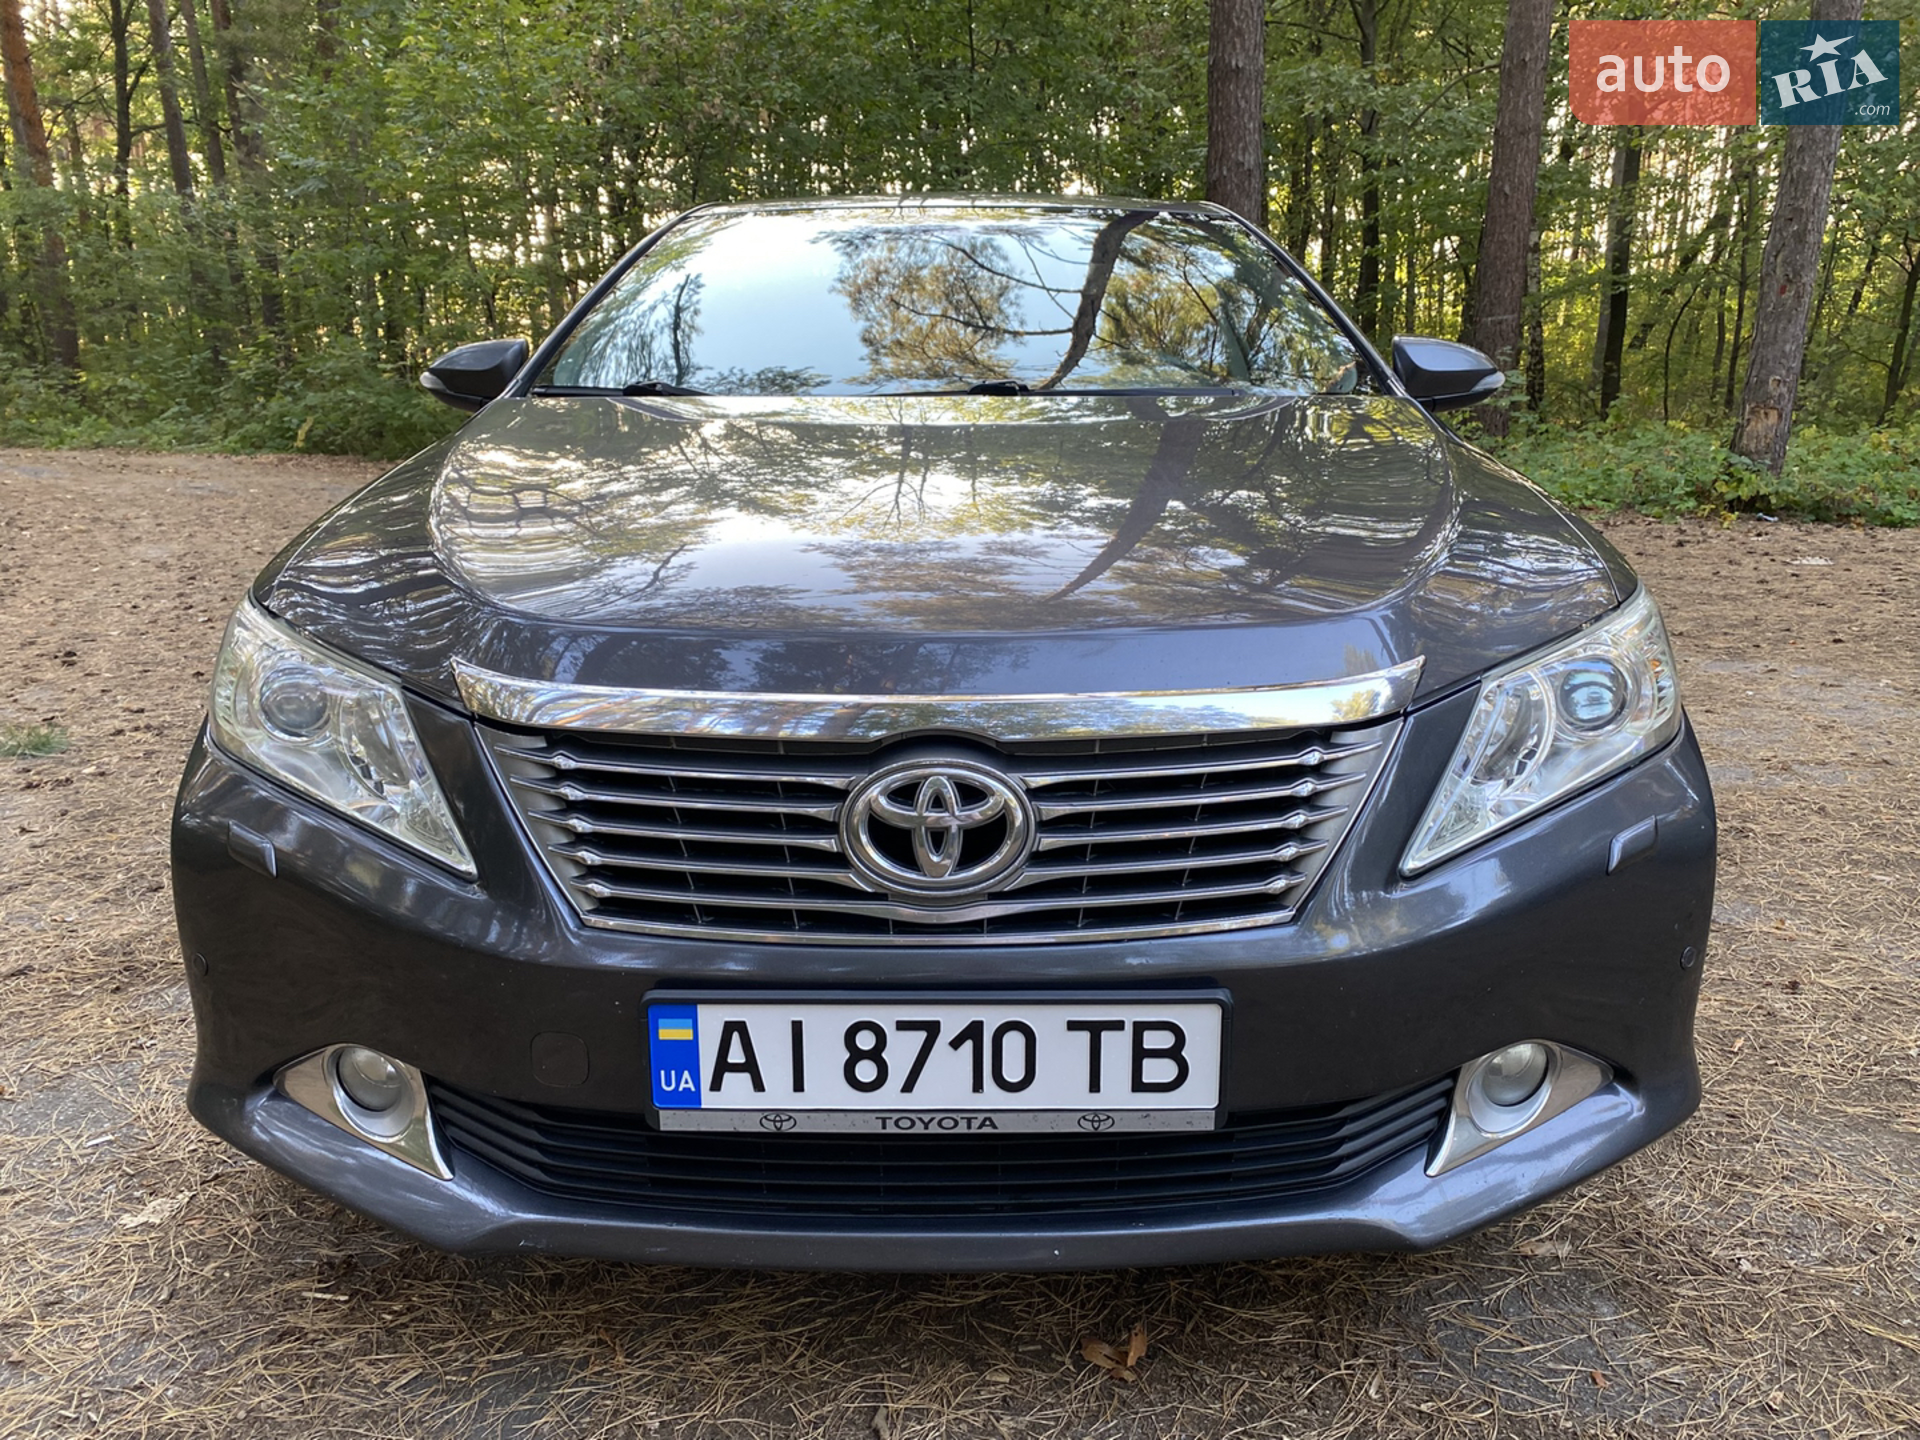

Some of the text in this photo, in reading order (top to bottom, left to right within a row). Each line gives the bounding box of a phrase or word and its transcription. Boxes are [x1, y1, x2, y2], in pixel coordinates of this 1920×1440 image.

[709, 1019, 1190, 1093] AI 8710 TB
[660, 1070, 696, 1092] UA
[874, 1115, 999, 1131] TOYOTA
